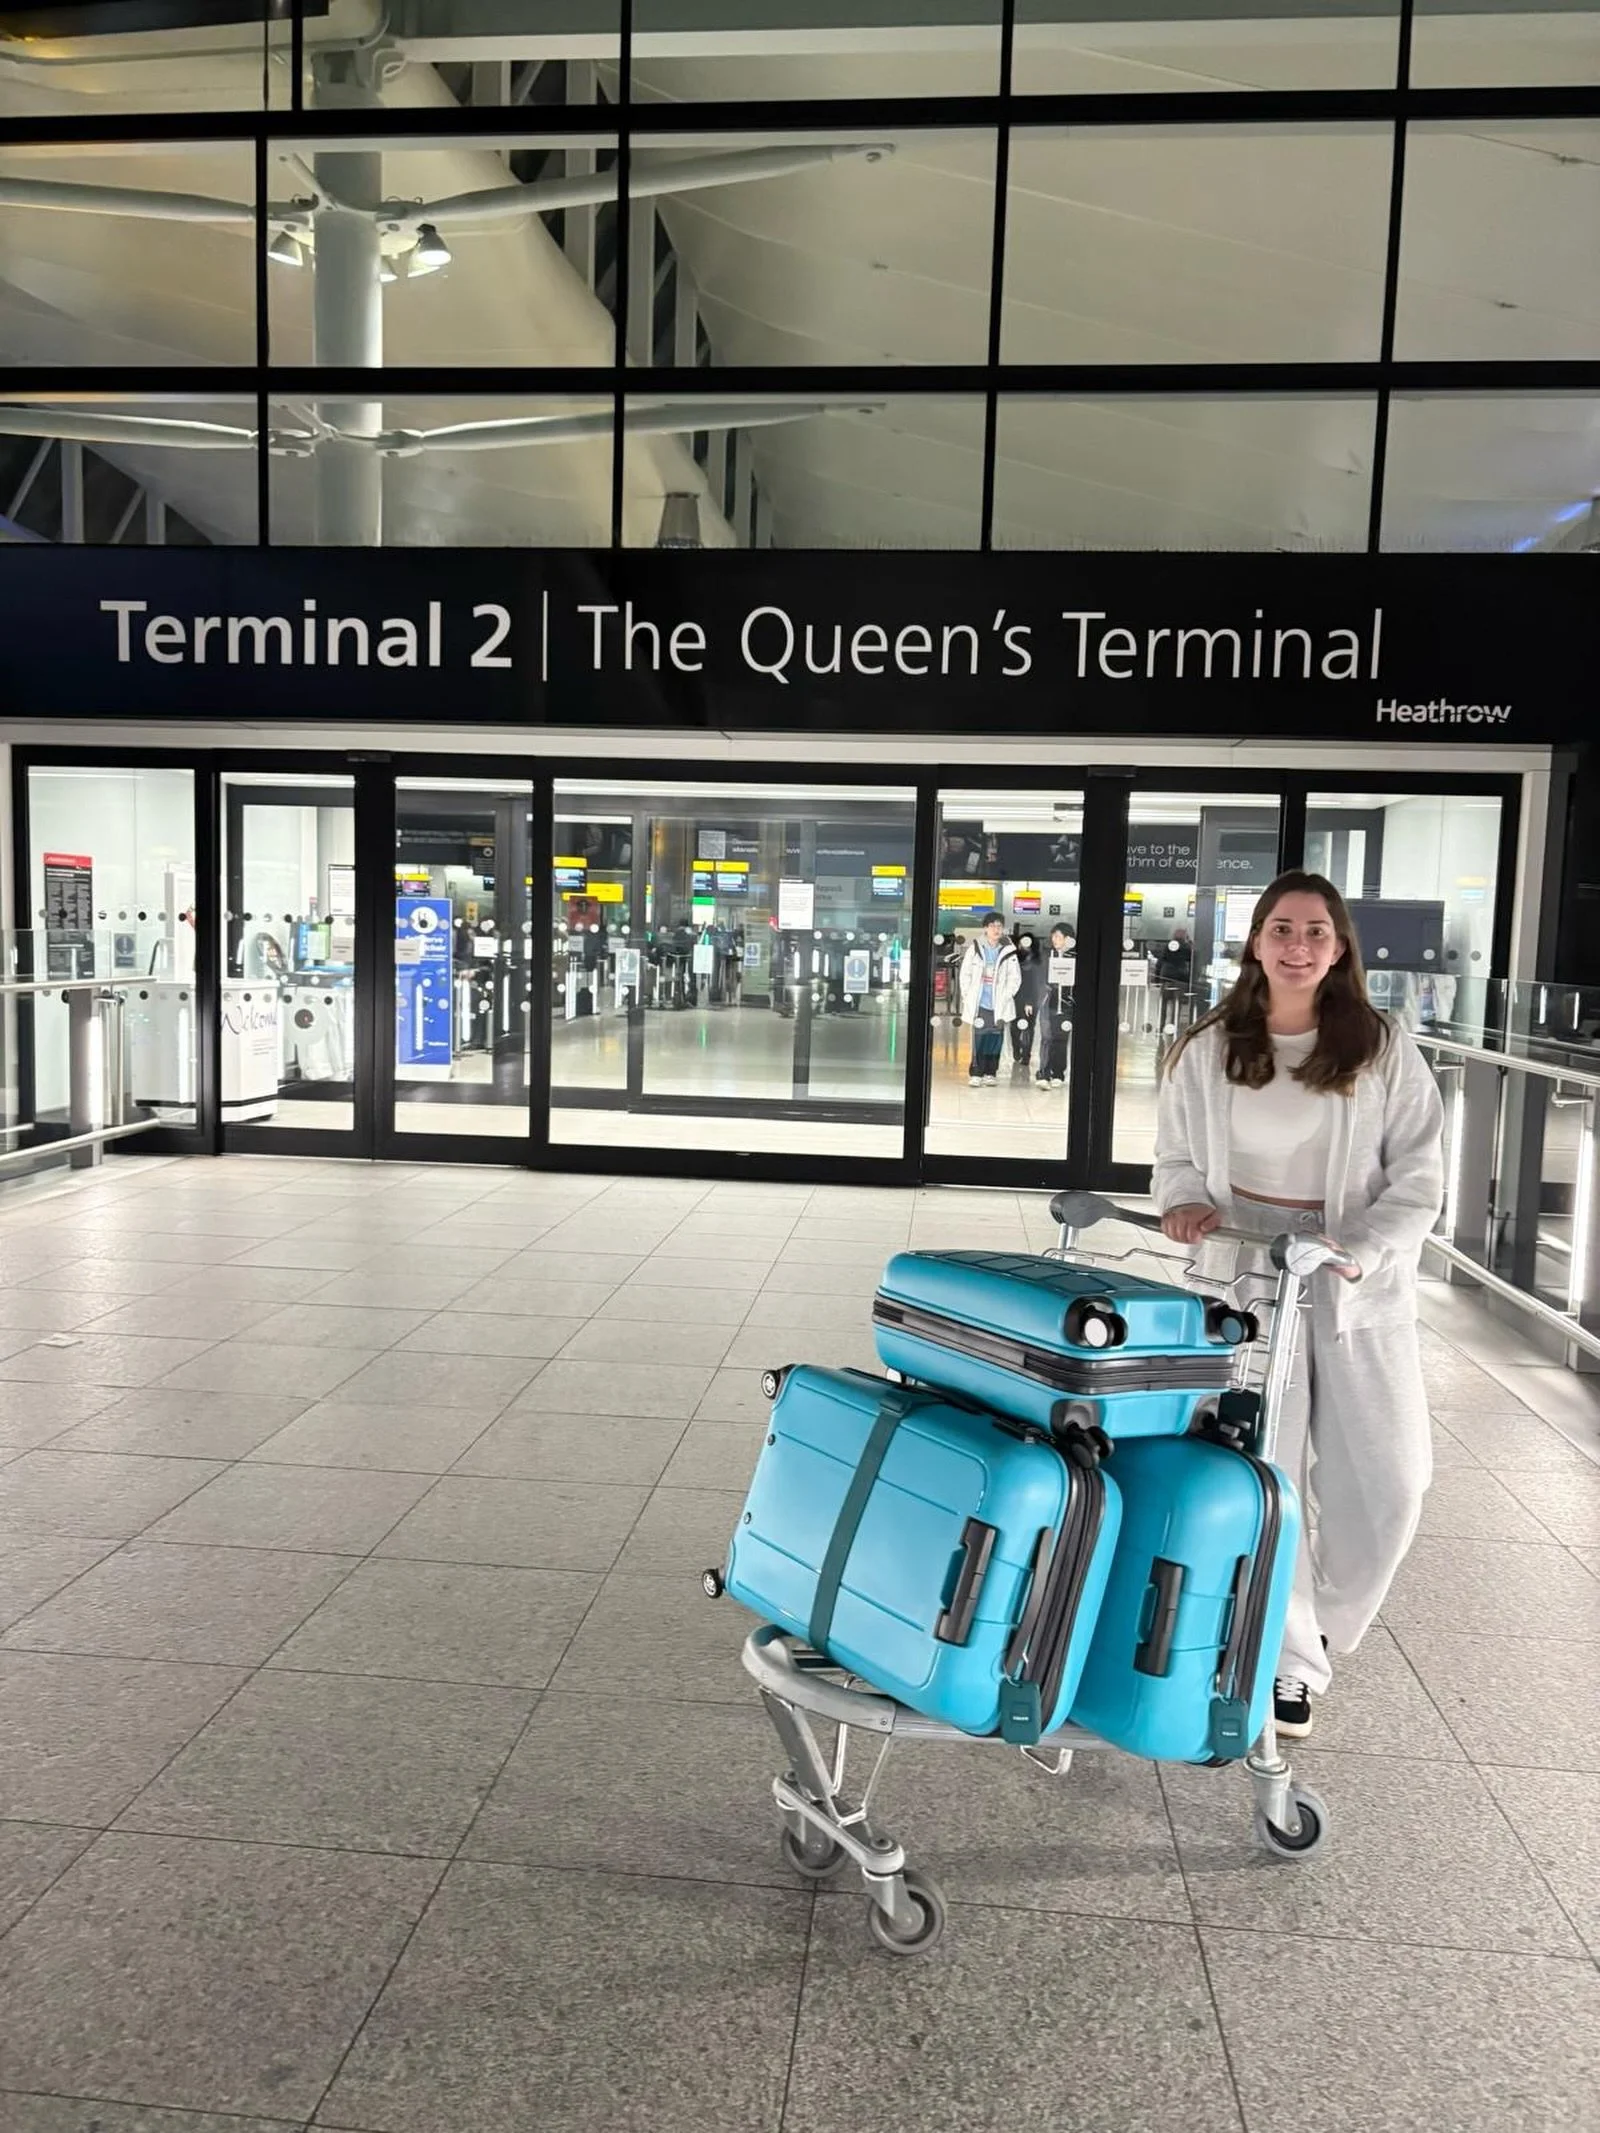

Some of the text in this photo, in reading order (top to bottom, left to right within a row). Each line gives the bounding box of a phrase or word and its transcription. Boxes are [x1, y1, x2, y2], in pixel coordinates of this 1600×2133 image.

[100, 599, 1382, 684] Terminal 2 The Queen's Terminal
[1375, 697, 1512, 723] Heathrow
[1150, 844, 1165, 856] to
[1168, 843, 1190, 856] the
[1159, 856, 1172, 869] of
